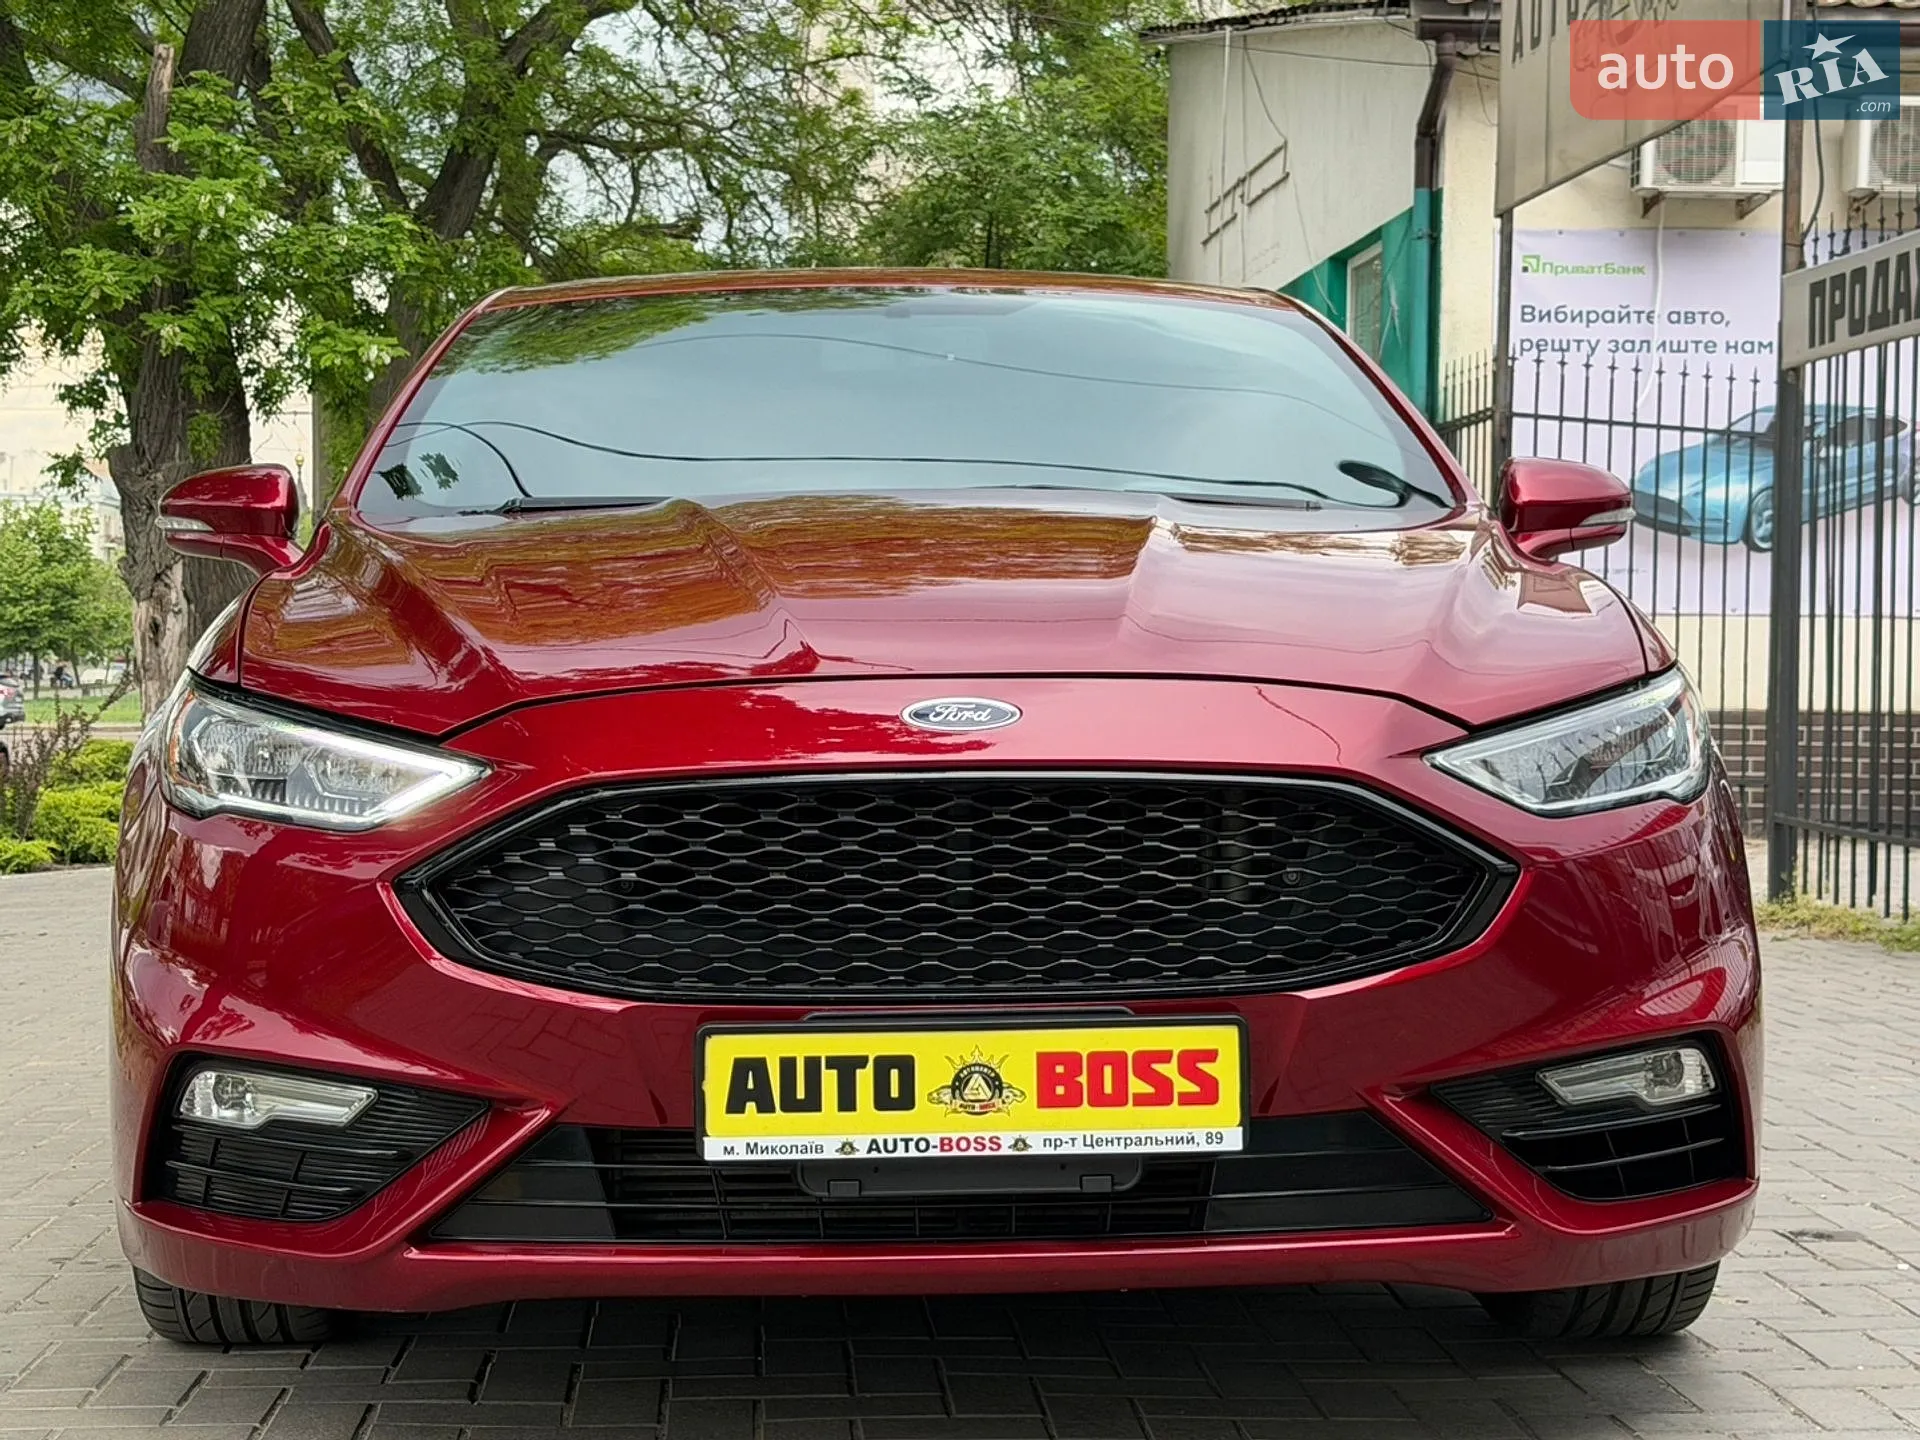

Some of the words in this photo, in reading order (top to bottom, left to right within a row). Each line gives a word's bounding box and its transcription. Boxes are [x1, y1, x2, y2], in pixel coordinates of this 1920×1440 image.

[1541, 262, 1646, 276] ПриватБанк
[1520, 304, 1656, 328] Вибирайте
[1667, 310, 1730, 327] авто,
[1520, 338, 1601, 357] решту
[1608, 339, 1717, 354] залиште
[1725, 340, 1773, 354] нам
[929, 703, 992, 722] Ford
[725, 1054, 916, 1114] AUTO
[1035, 1049, 1219, 1109] BOSS
[723, 1144, 740, 1156] м.
[745, 1140, 825, 1155] Миколаїв
[866, 1137, 1003, 1155] AUTO-BOSS
[1042, 1136, 1078, 1149] пр-т
[1082, 1132, 1200, 1149] Центральний,
[1205, 1131, 1225, 1145] 89
